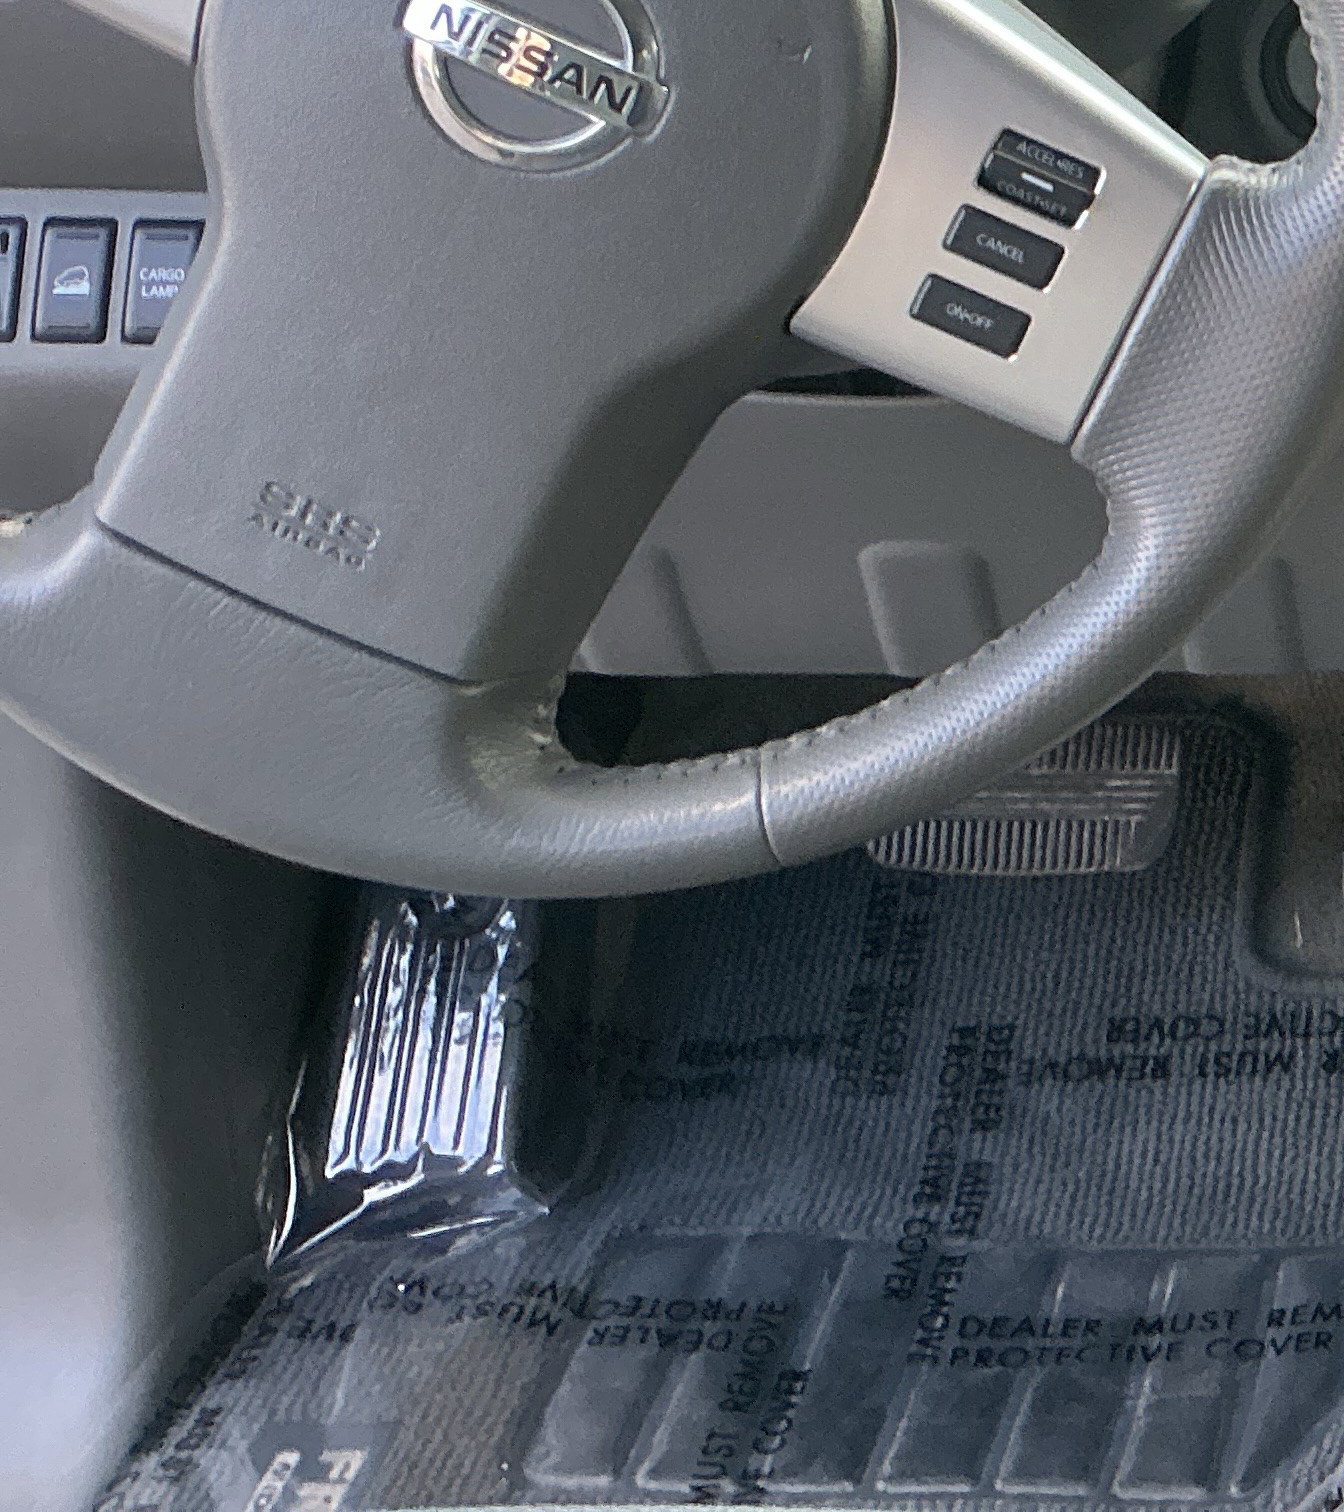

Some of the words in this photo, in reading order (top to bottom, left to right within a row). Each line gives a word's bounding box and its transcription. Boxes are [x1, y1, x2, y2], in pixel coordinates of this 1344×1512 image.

[429, 2, 639, 116] NISSAN
[975, 233, 1025, 265] CANCEL
[139, 266, 186, 282] CARGO
[1106, 1013, 1226, 1045] COVER
[1018, 1051, 1172, 1085] REMOVE
[1198, 1049, 1295, 1081] MUST
[587, 1324, 734, 1354] DEALER
[956, 1313, 1104, 1341] DEALER
[1130, 1307, 1242, 1337] MUST
[948, 1341, 1185, 1370] PROTECTIVE
[1205, 1330, 1335, 1363] COVER
